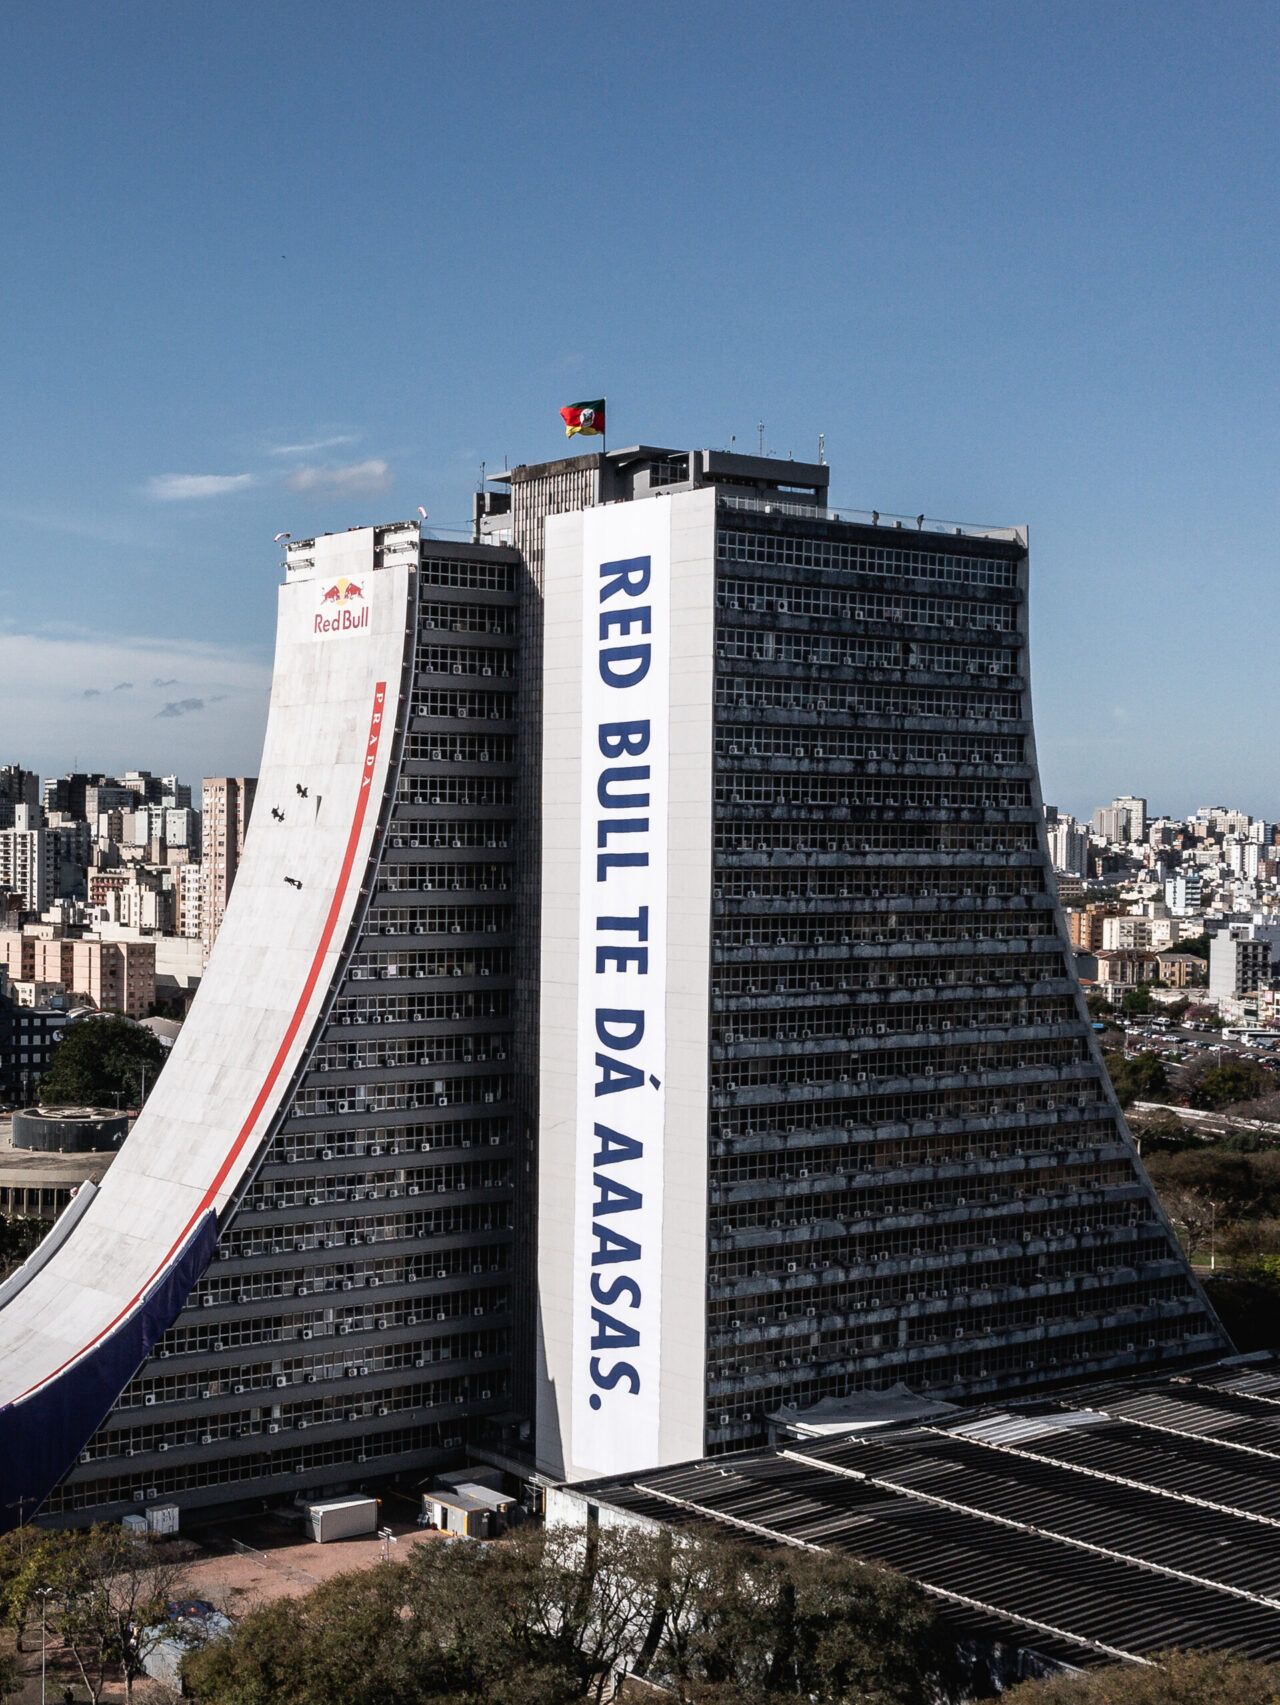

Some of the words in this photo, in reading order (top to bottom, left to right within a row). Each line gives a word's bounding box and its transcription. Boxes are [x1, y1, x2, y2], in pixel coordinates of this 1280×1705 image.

[314, 610, 341, 633] Red
[343, 606, 369, 630] Bull
[598, 555, 652, 689] RED
[362, 692, 384, 787] PRADA
[596, 719, 651, 882] BULL
[594, 905, 649, 975] TE
[594, 1008, 661, 1098] DÁ
[589, 1122, 644, 1411] AAASAS.
